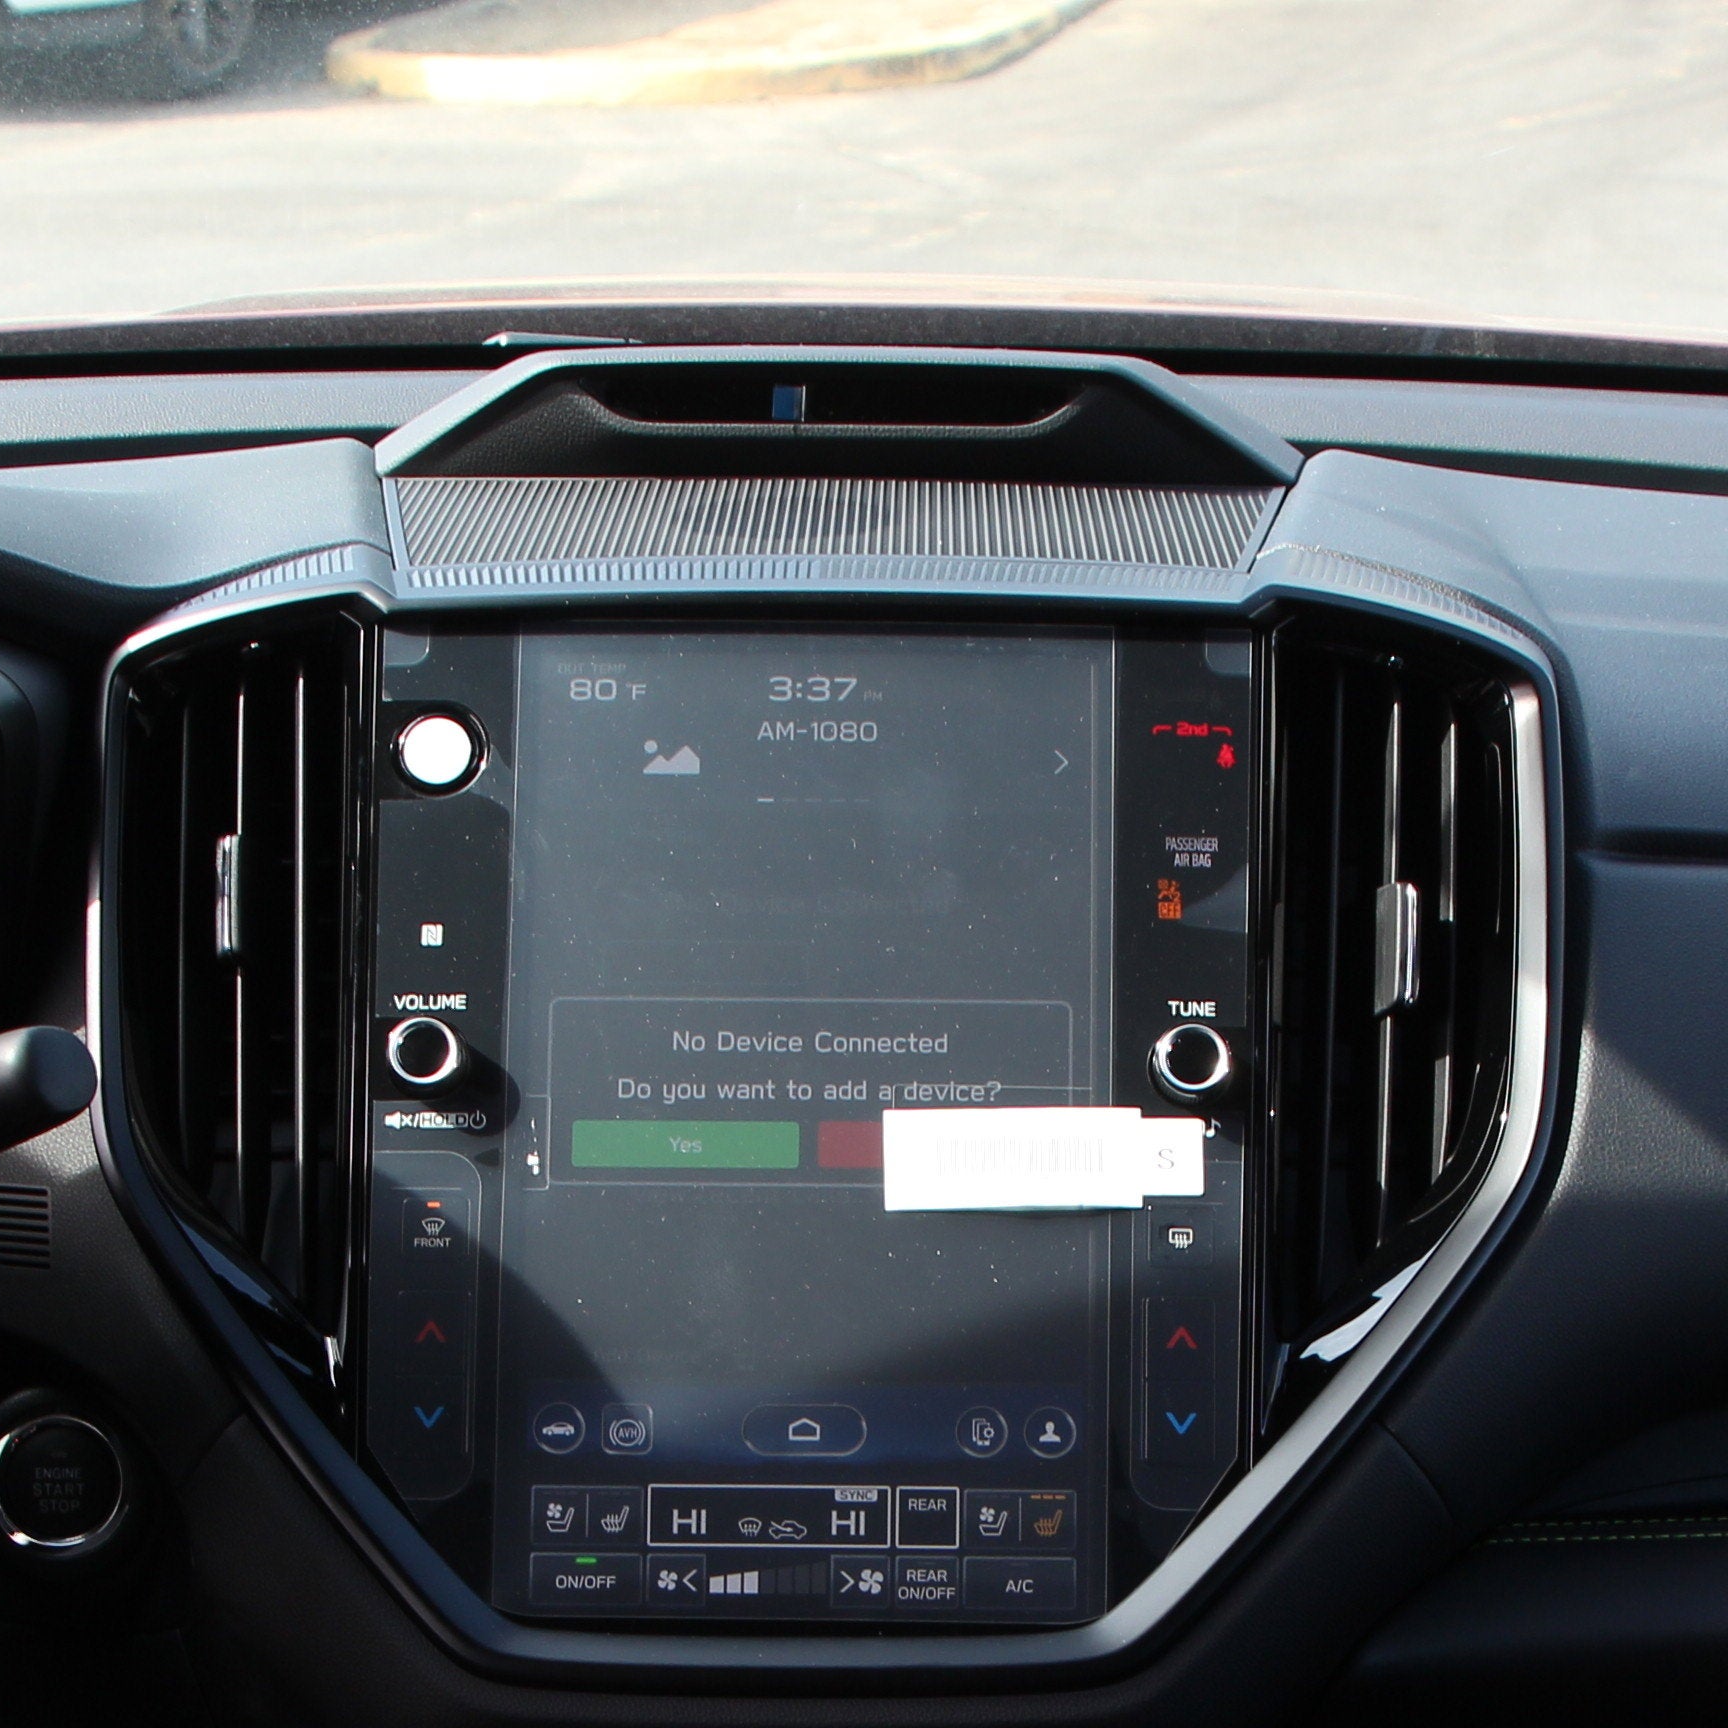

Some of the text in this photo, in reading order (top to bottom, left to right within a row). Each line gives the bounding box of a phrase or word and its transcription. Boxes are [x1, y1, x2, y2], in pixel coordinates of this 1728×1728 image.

[569, 678, 618, 701] 80
[768, 676, 859, 702] 3:37
[756, 721, 878, 743] AM-1080
[1176, 721, 1210, 737] 2nd
[1165, 836, 1219, 852] PASSENGER
[1174, 852, 1212, 868] AIR BAG
[393, 994, 467, 1010] VOLUME
[1168, 1000, 1217, 1018] TUNE
[671, 1031, 949, 1054] No Device Connected
[617, 1079, 1002, 1105] Do you want to add a device?
[669, 1136, 703, 1154] Yes
[414, 1237, 452, 1248] FRONT
[617, 1426, 638, 1440] AVH
[34, 1467, 82, 1480] ENGINE
[33, 1483, 85, 1496] START
[839, 1489, 874, 1500] SYNC
[39, 1499, 81, 1514] STOP
[908, 1499, 947, 1511] REAR
[672, 1508, 707, 1535] HI
[830, 1510, 866, 1536] HI
[555, 1575, 616, 1590] ON/OFF
[906, 1569, 948, 1582] REAR
[898, 1586, 956, 1600] ON/OFF
[1005, 1579, 1034, 1593] A/C
